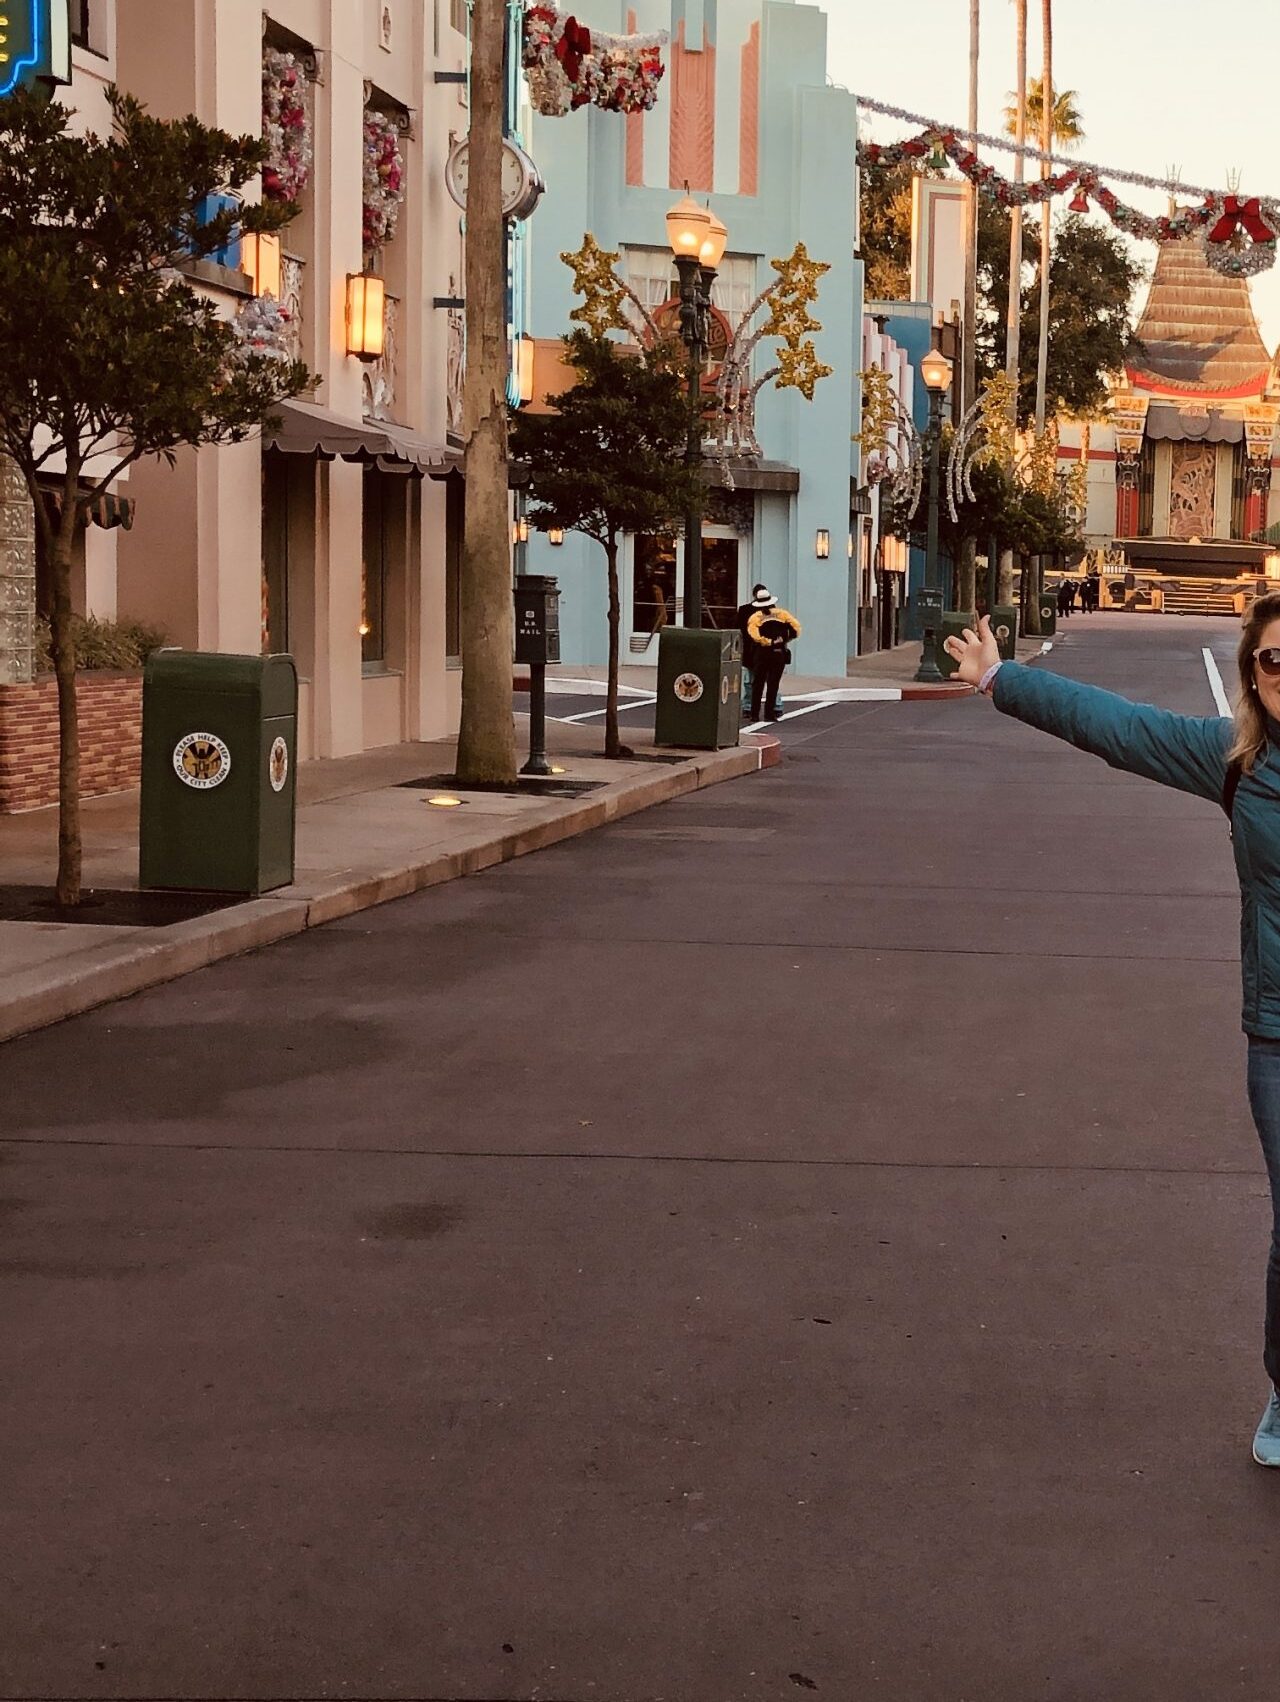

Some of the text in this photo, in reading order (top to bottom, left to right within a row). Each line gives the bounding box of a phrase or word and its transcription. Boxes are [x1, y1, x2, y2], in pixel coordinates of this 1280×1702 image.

[176, 734, 229, 760] PLEASE HELP KEEP
[176, 764, 189, 780] OUR
[190, 778, 207, 788] CITY
